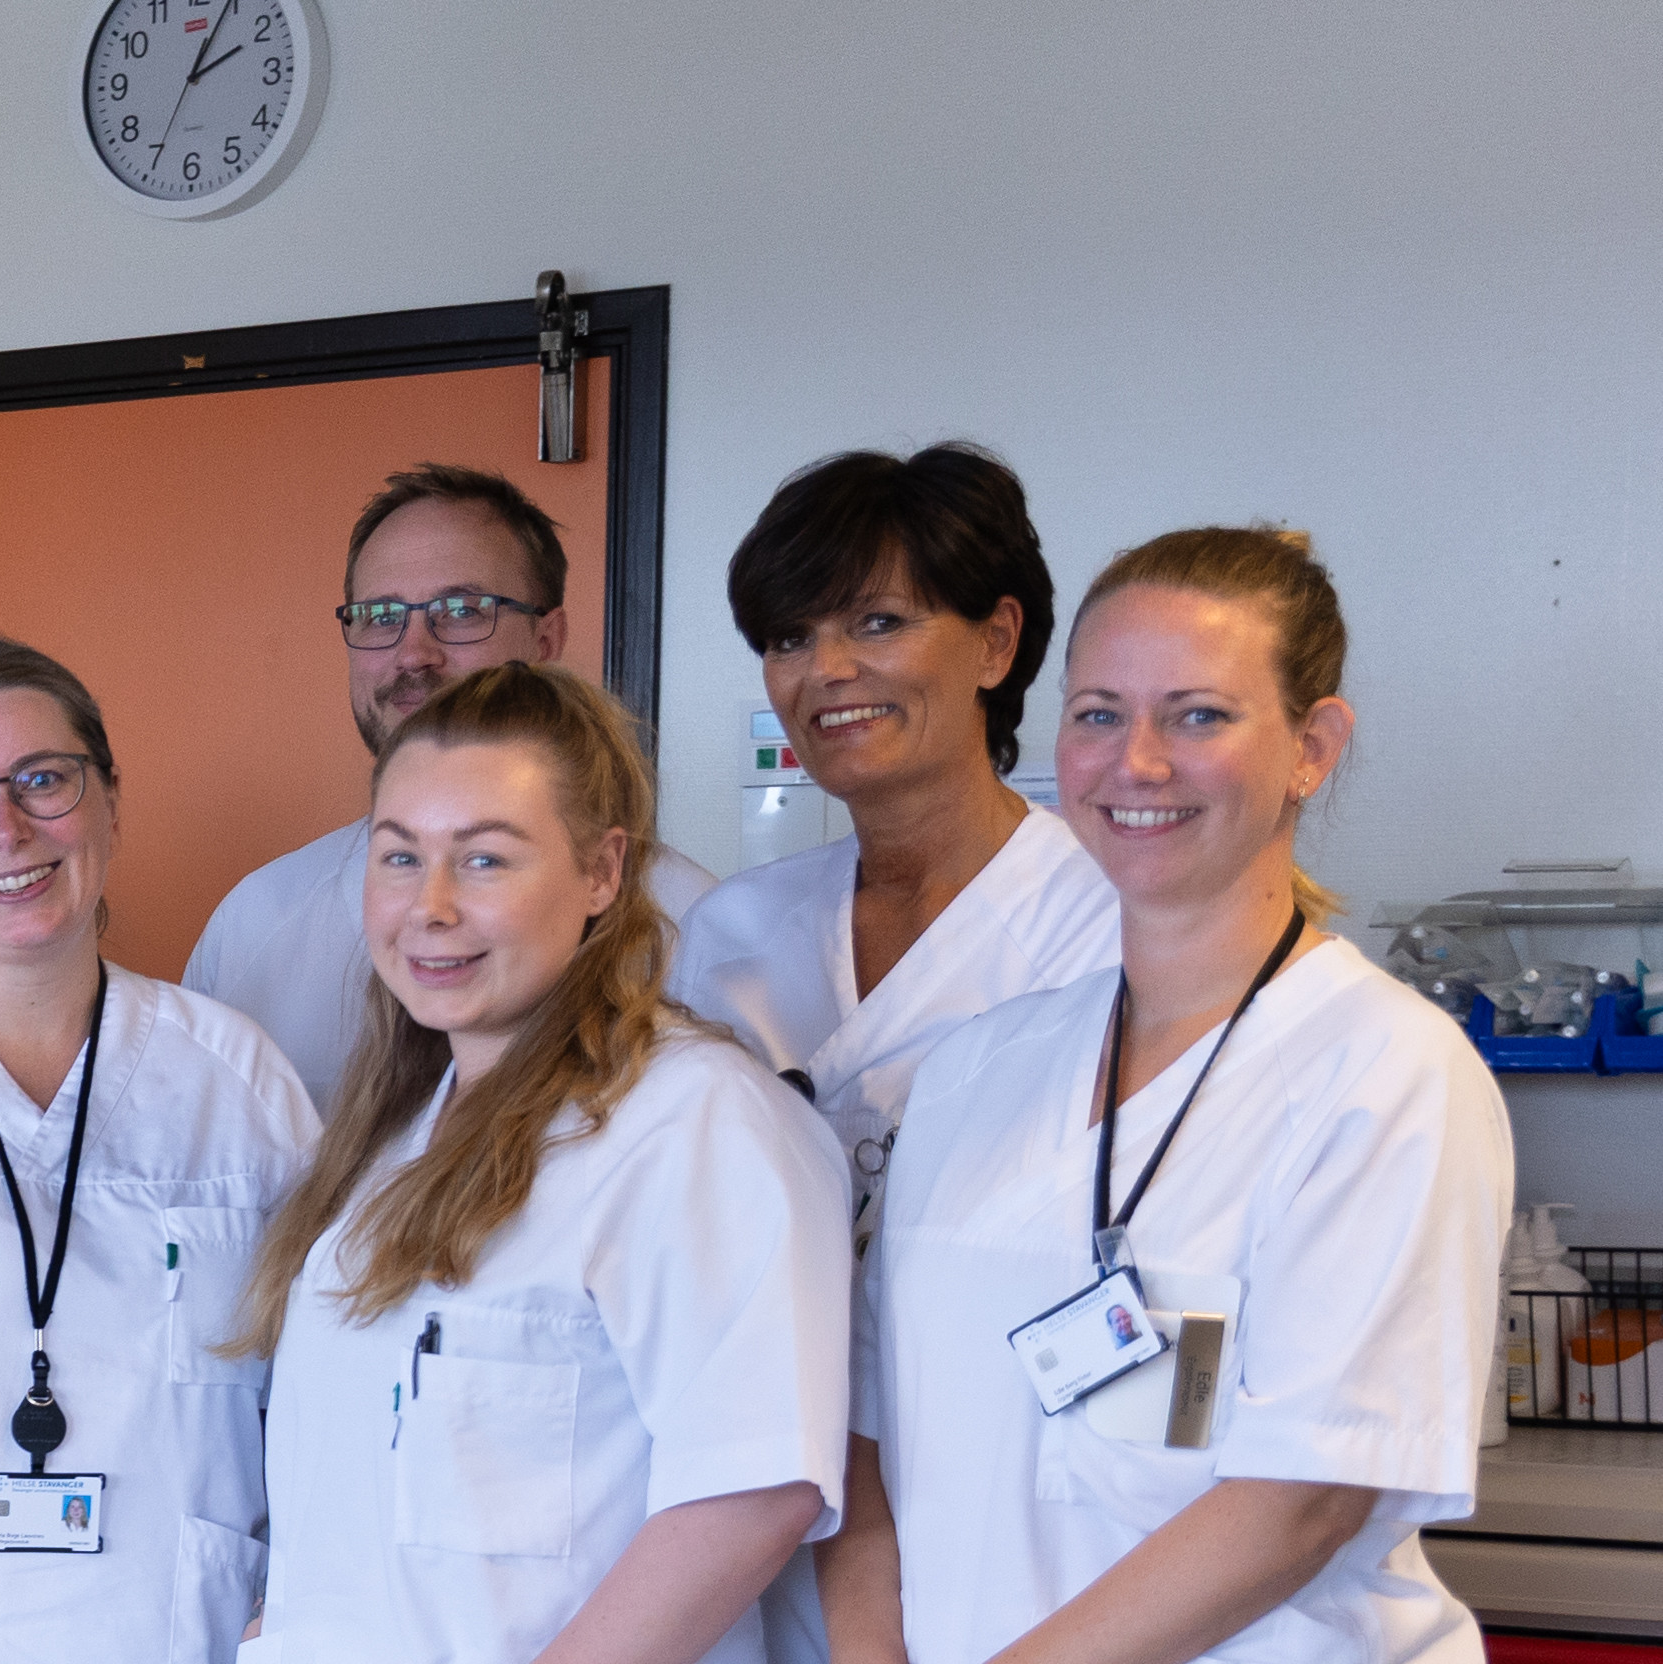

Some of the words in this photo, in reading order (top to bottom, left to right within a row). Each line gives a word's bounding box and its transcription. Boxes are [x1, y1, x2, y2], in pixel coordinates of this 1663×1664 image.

[147, 0, 167, 24] 11
[254, 15, 271, 42] 2
[120, 31, 148, 59] 10
[262, 57, 281, 85] 3
[111, 73, 128, 100] 9
[121, 115, 139, 142] 8
[251, 104, 269, 131] 4
[149, 143, 164, 170] 7
[223, 136, 241, 164] 5
[183, 152, 200, 180] 6
[38, 1481, 85, 1489] STAVANGER
